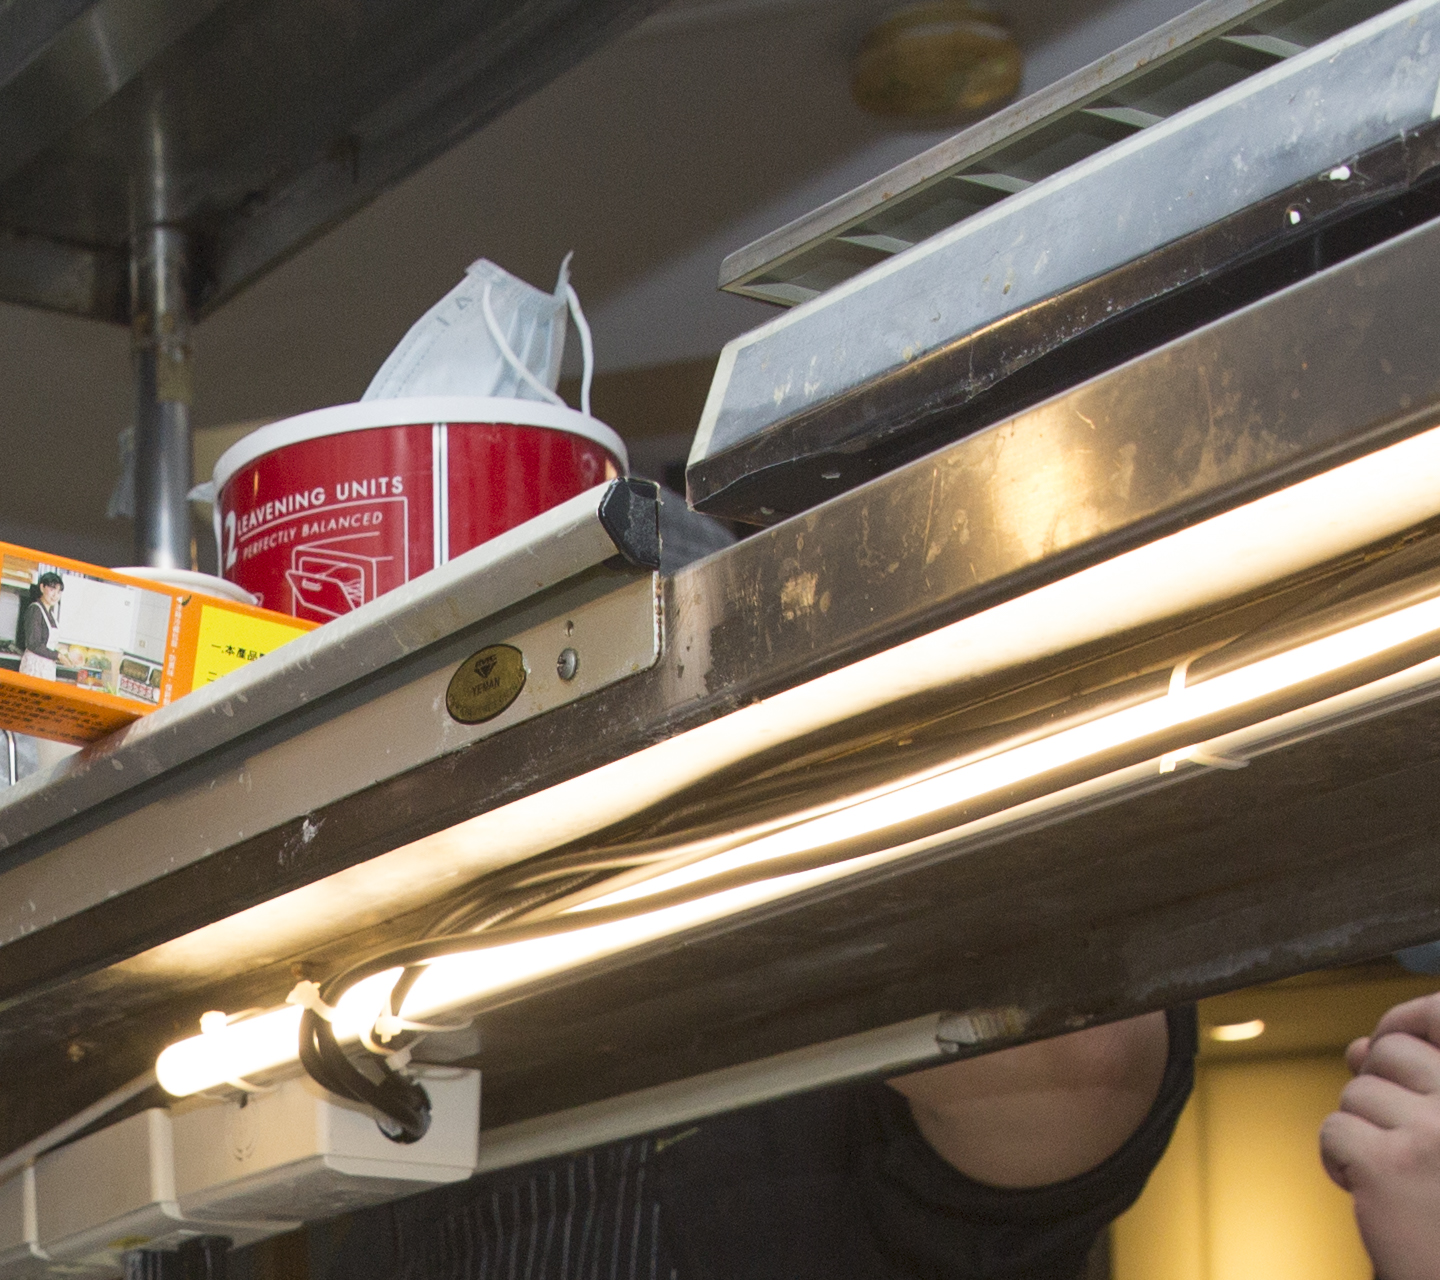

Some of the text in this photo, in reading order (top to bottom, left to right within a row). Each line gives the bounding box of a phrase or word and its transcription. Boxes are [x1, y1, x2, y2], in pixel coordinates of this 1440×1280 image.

[237, 487, 326, 536] LEAVENING
[336, 476, 404, 501] UNITS
[243, 511, 383, 560] PERFECTLY BALANCED
